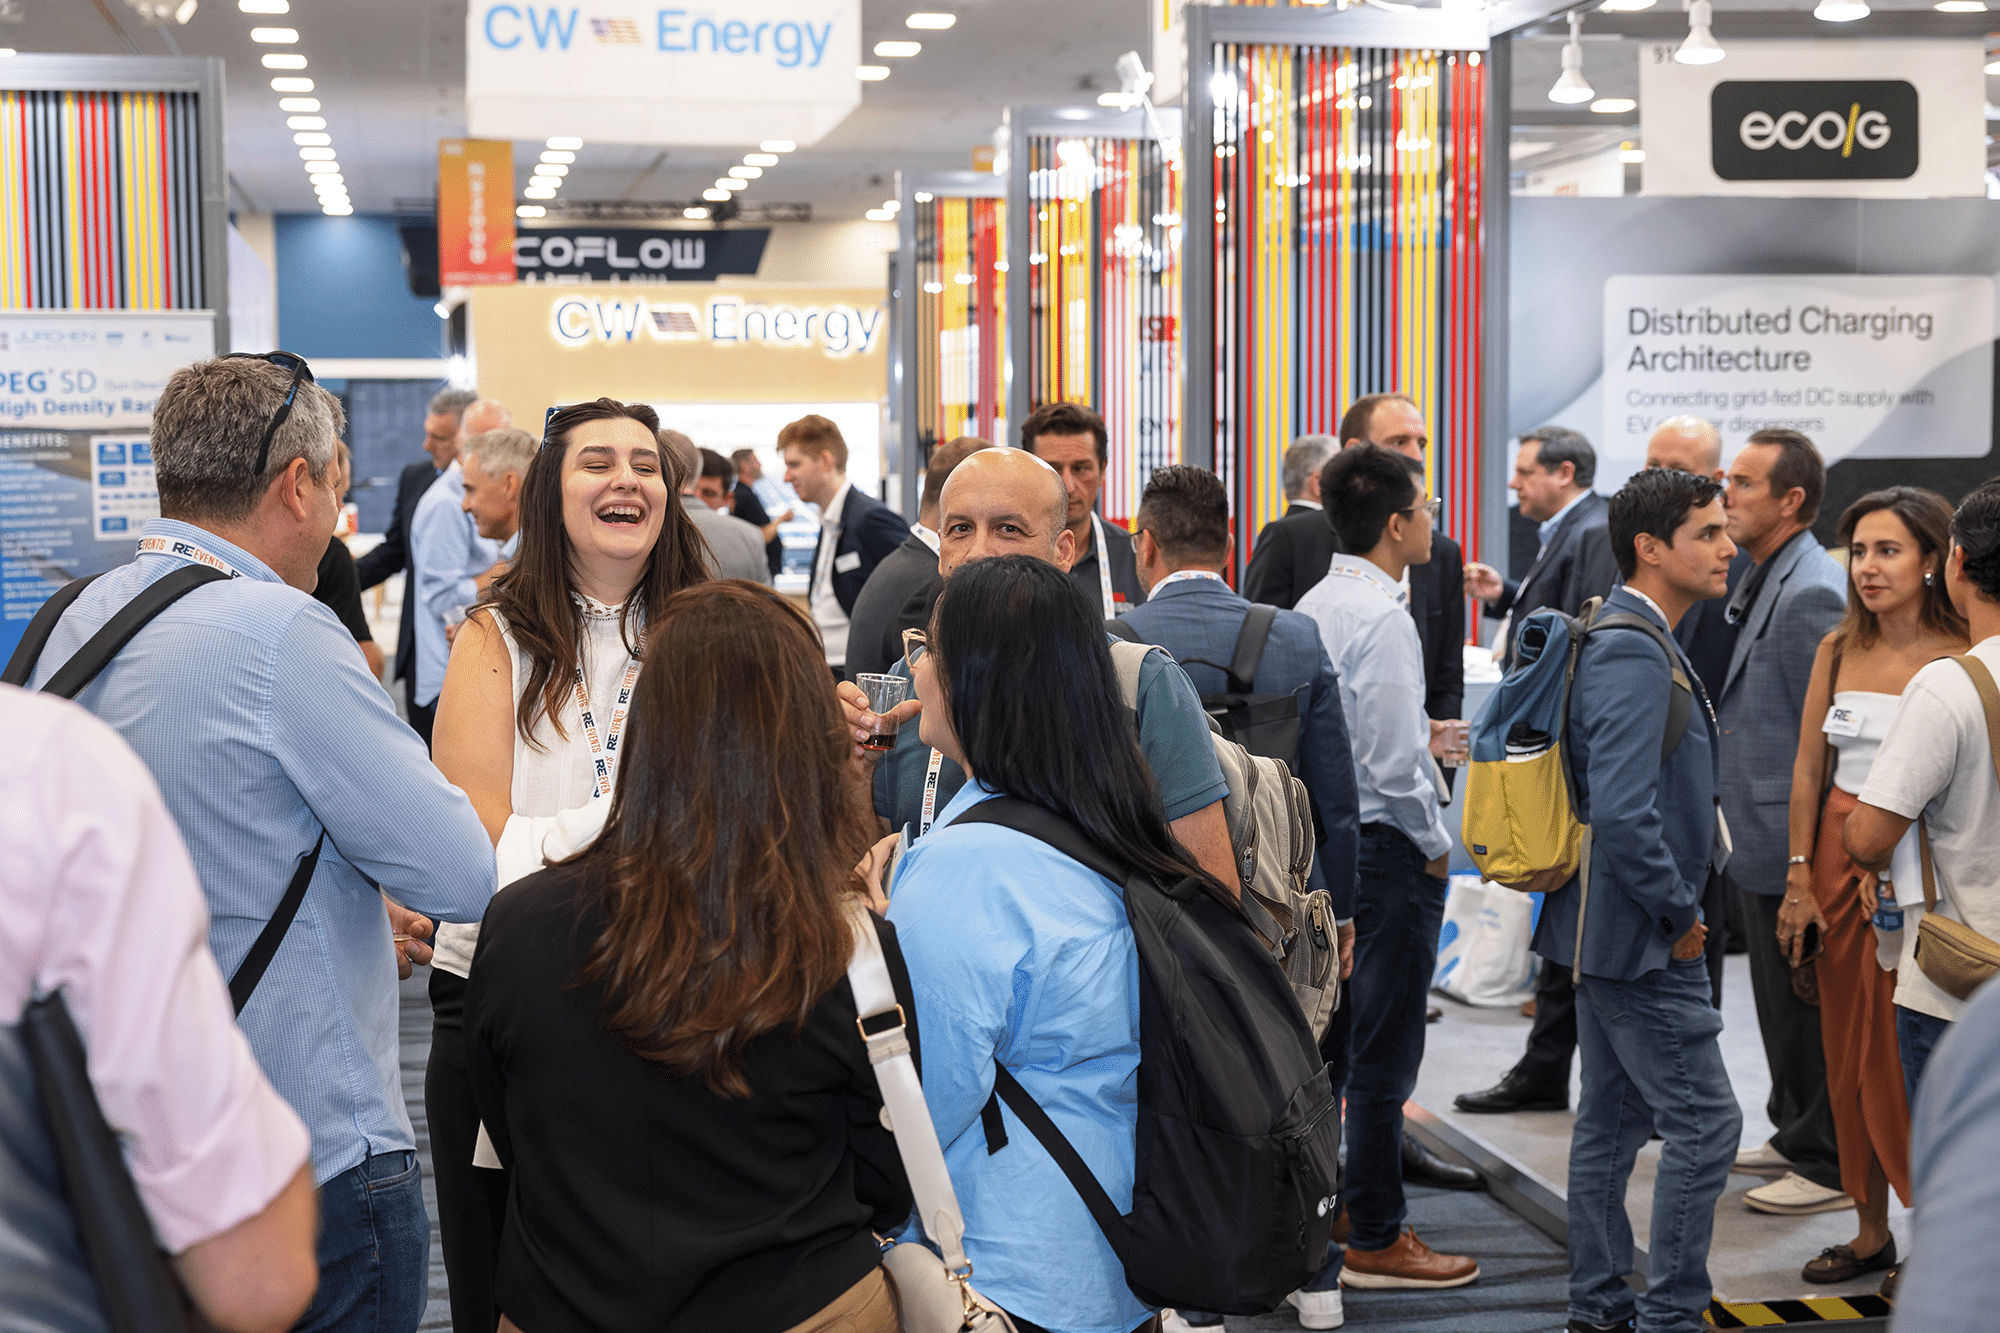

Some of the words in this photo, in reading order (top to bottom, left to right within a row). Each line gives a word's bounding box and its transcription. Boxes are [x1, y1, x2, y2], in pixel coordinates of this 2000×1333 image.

[484, 5, 579, 50] CW
[656, 9, 832, 68] Energy
[556, 301, 640, 342] CW
[712, 303, 880, 353] Energy
[1627, 307, 1791, 336] Distributed
[1799, 306, 1934, 341] Charging
[1627, 345, 1812, 373] Architecture
[60, 368, 97, 394] SD
[43, 398, 116, 418] Density
[1626, 388, 1728, 411] Connecting
[1805, 386, 1834, 407] DC
[1837, 388, 1896, 410] supply
[1626, 415, 1653, 434] EV
[194, 549, 224, 570] EVENTS
[624, 666, 638, 688] EVENTS
[610, 709, 625, 734] EVENTS
[586, 727, 602, 754] EVENTS
[924, 789, 934, 815] EVENTS
